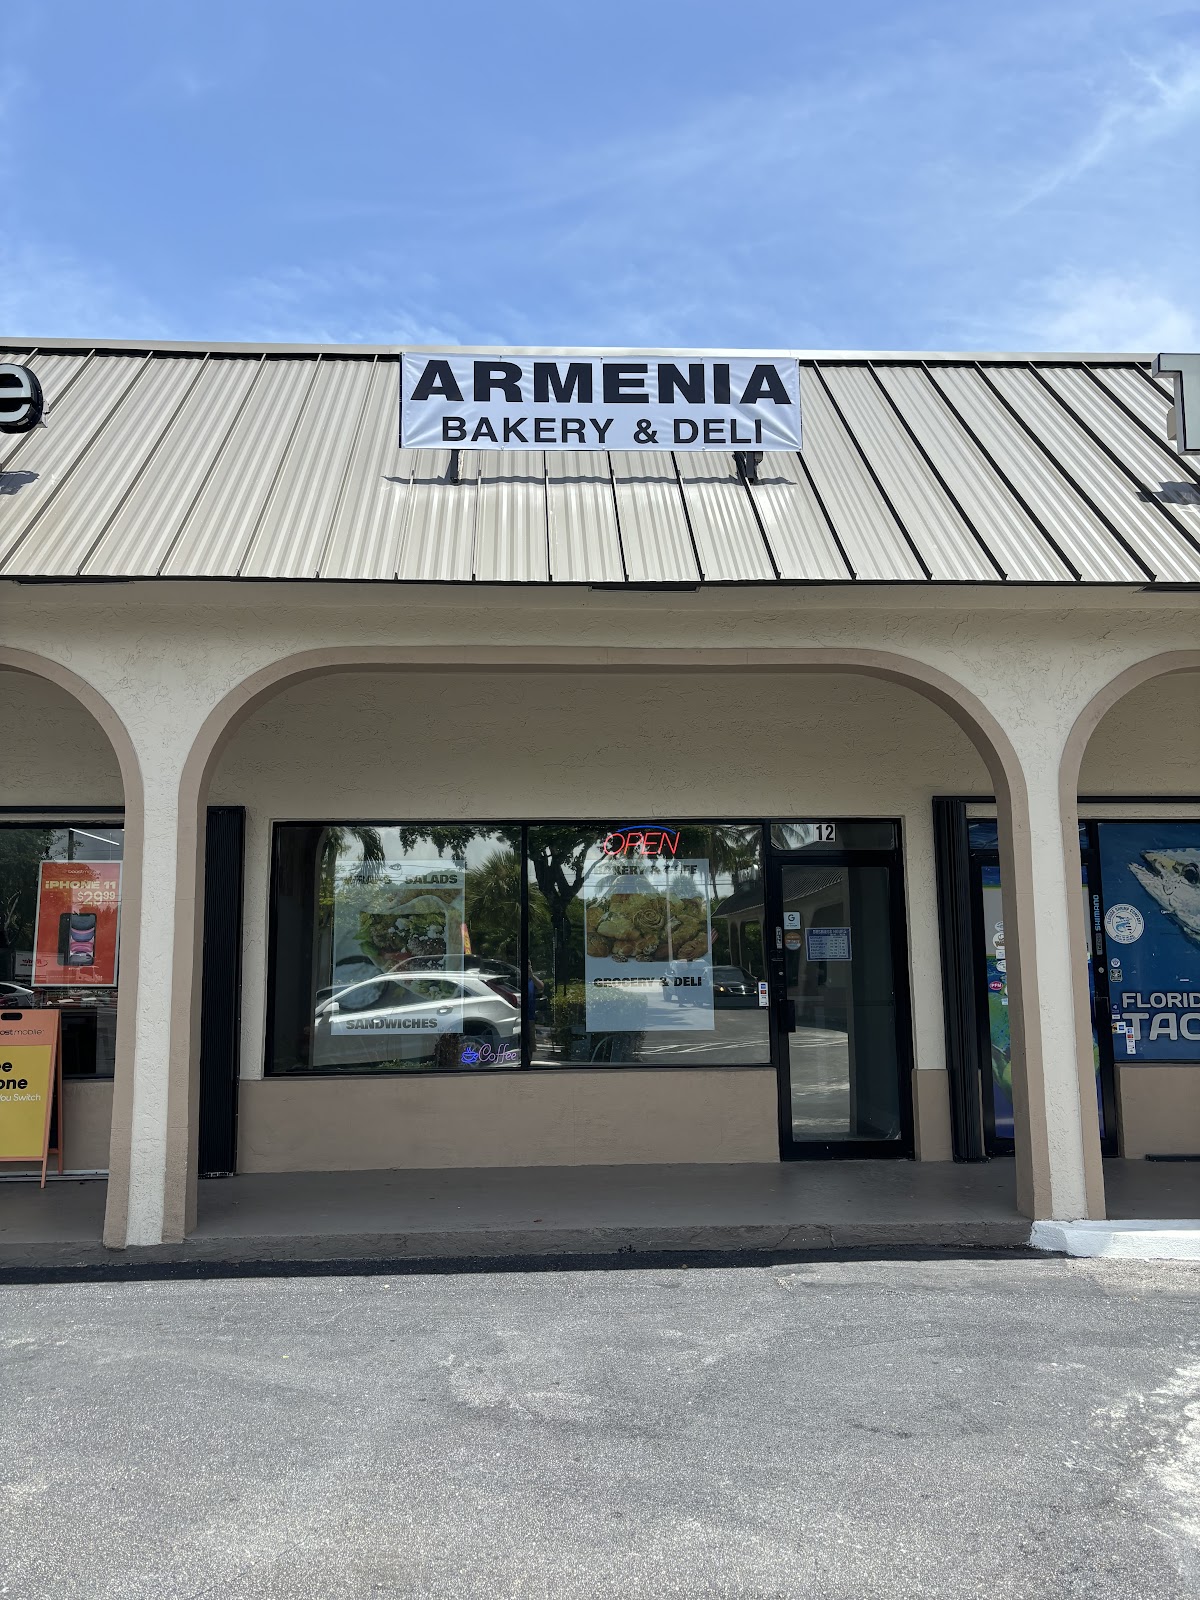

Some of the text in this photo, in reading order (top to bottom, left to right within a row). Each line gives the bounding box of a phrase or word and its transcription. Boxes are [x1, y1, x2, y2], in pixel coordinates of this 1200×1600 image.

[411, 359, 792, 405] ARMENIA
[442, 416, 762, 444] BAKERY & DELI
[815, 824, 834, 841] 12
[603, 831, 680, 855] OPEN
[45, 880, 116, 890] iPHONE 11
[404, 874, 458, 885] SALADS
[1093, 894, 1101, 932] SHIMANO
[593, 976, 655, 988] GROCERY
[674, 976, 702, 987] DELI
[346, 1017, 438, 1030] SANDWICHES
[478, 1043, 517, 1064] Coffee
[0, 1061, 13, 1073] e
[13, 1093, 41, 1102] Switch
